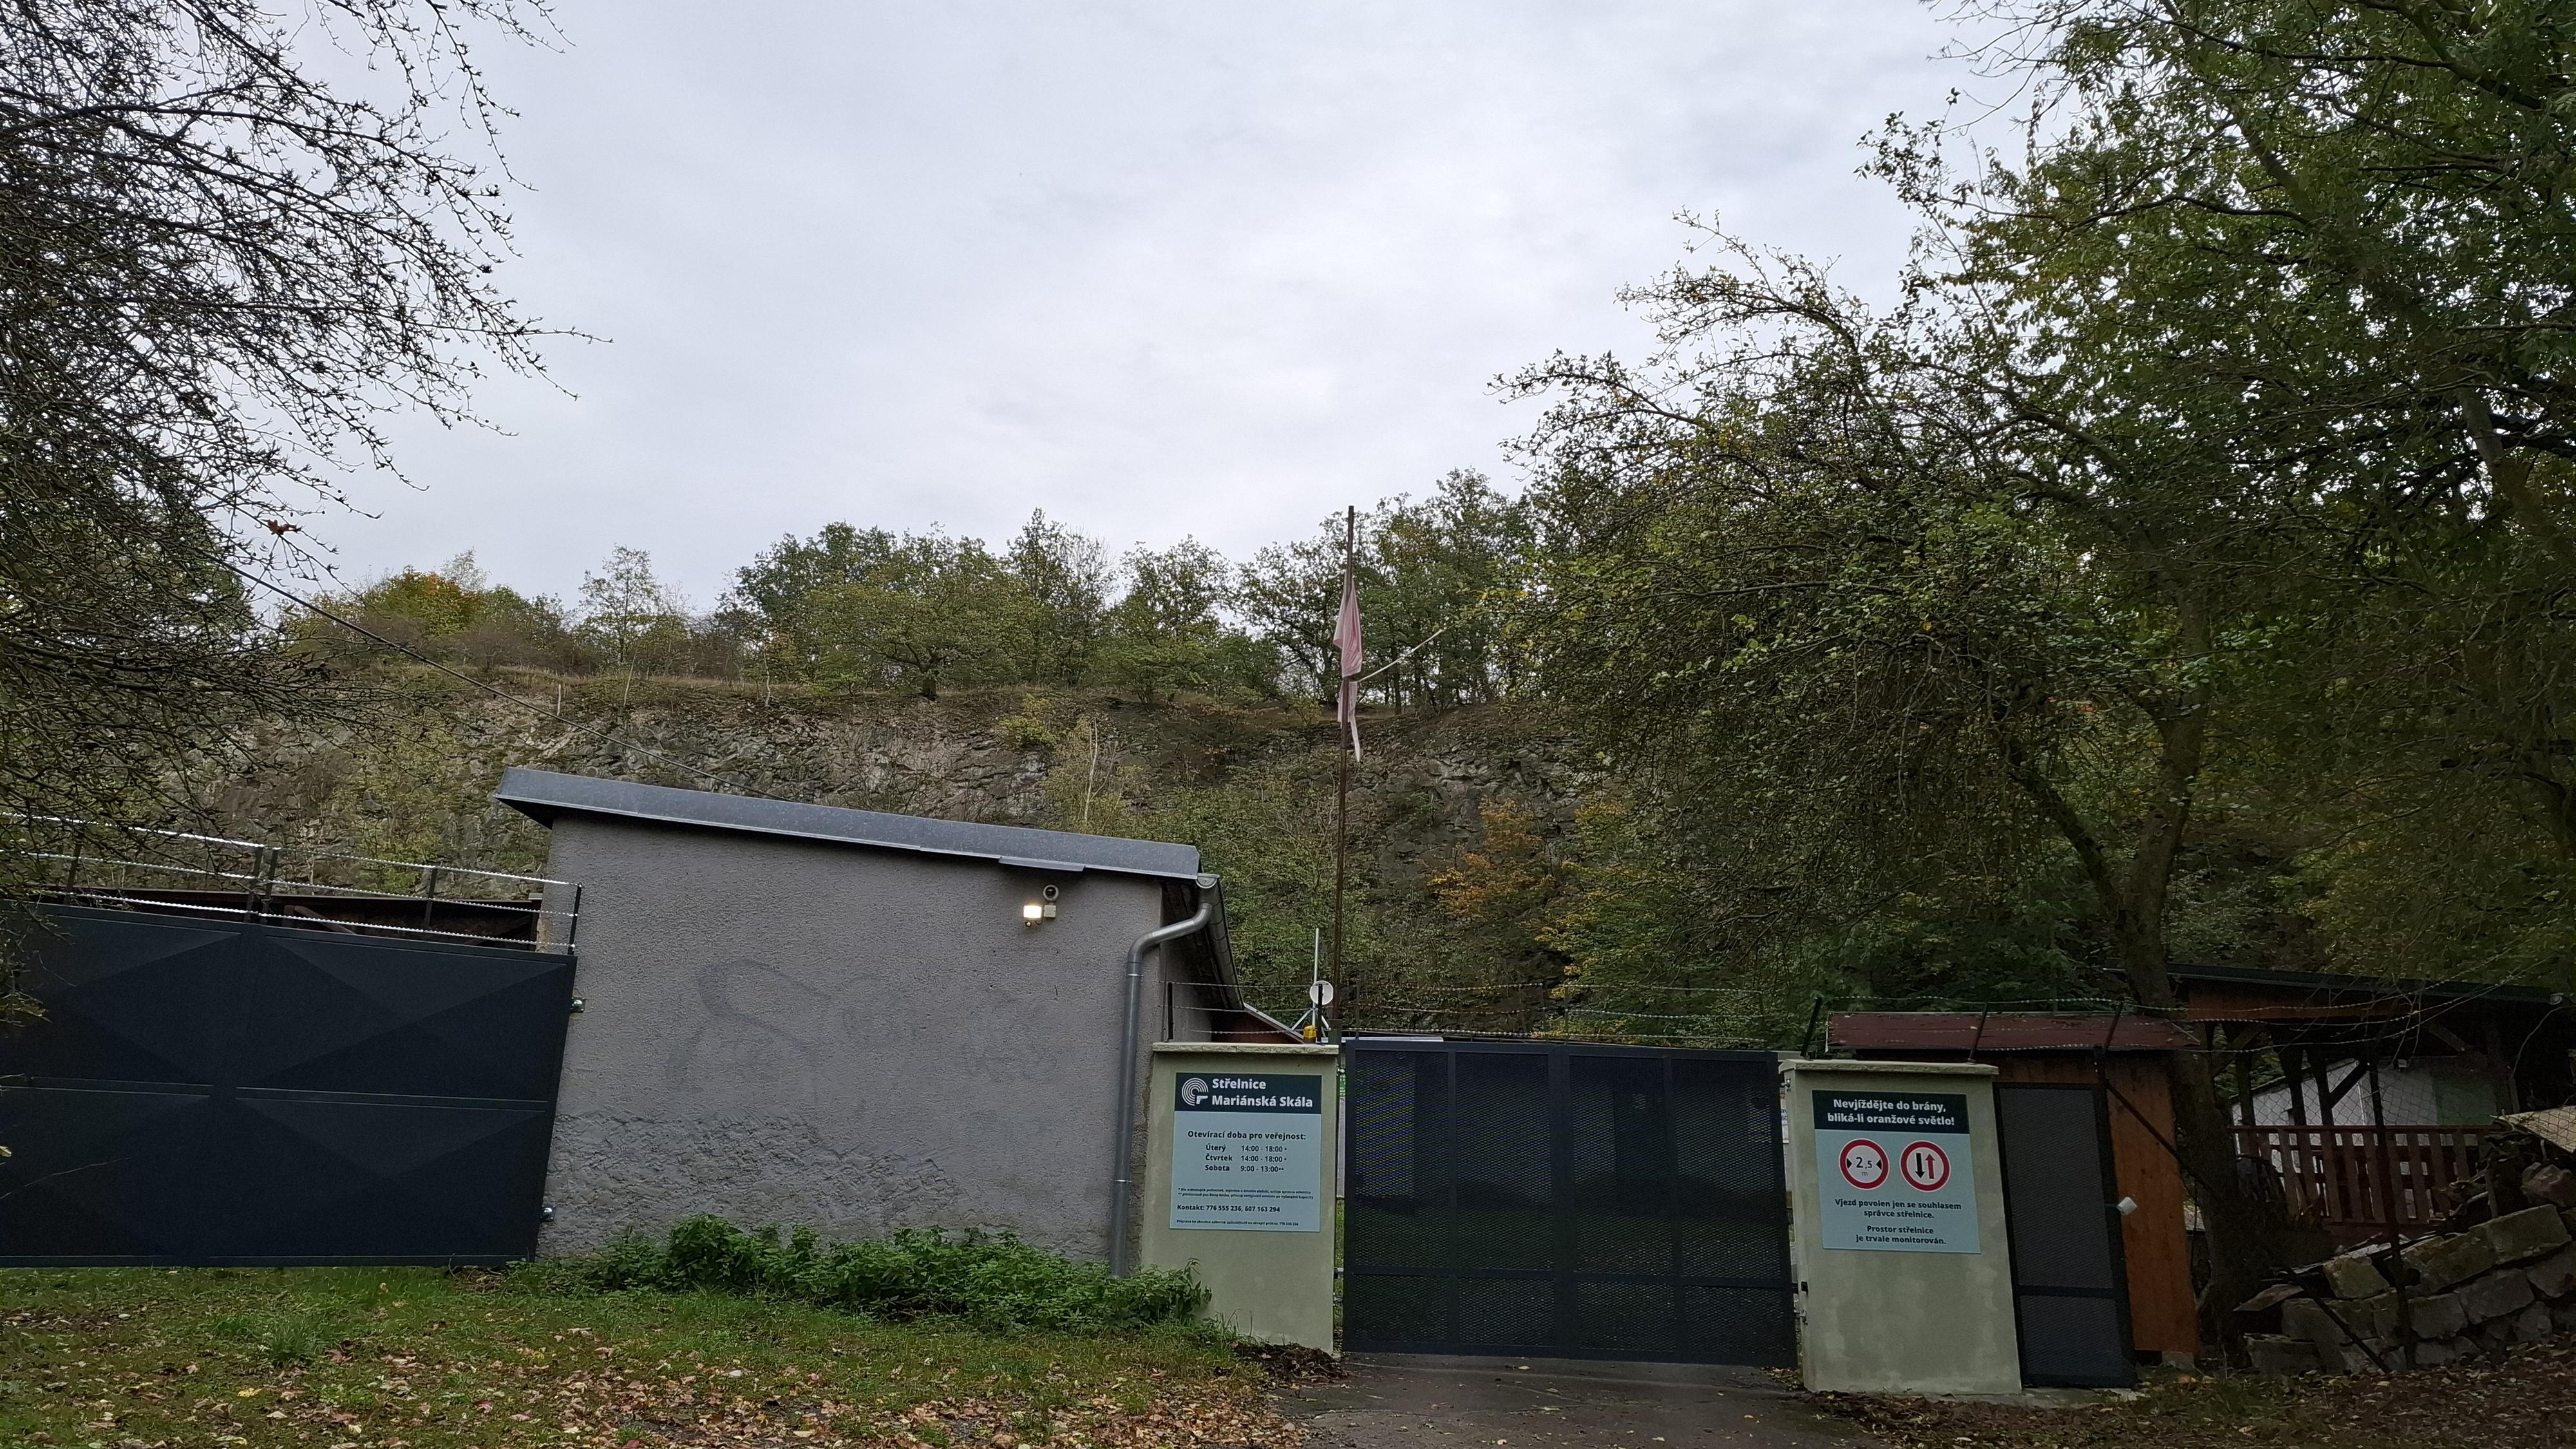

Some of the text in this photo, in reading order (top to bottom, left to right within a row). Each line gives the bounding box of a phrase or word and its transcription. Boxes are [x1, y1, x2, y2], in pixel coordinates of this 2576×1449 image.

[1212, 1078, 1266, 1089] Střelnice
[1211, 1095, 1313, 1108] Mariánská Skála
[1833, 1099, 1946, 1113] Nevjíždějte do brány,
[1828, 1113, 1955, 1126] bliká-li oranžové světlo!
[1188, 1130, 1226, 1139] Otevírací
[1249, 1132, 1263, 1141] pro
[1265, 1132, 1307, 1141] veřejnost:
[1206, 1143, 1226, 1153] Úterý
[1205, 1153, 1233, 1162] Čtvrtek
[1835, 1198, 1857, 1207] Vjezd
[1892, 1200, 1905, 1209] jen
[1863, 1209, 1895, 1218] správce
[1866, 1225, 1934, 1235] Prostor střelnice
[1855, 1235, 1864, 1243] je
[1891, 1236, 1947, 1245] monitorován.
